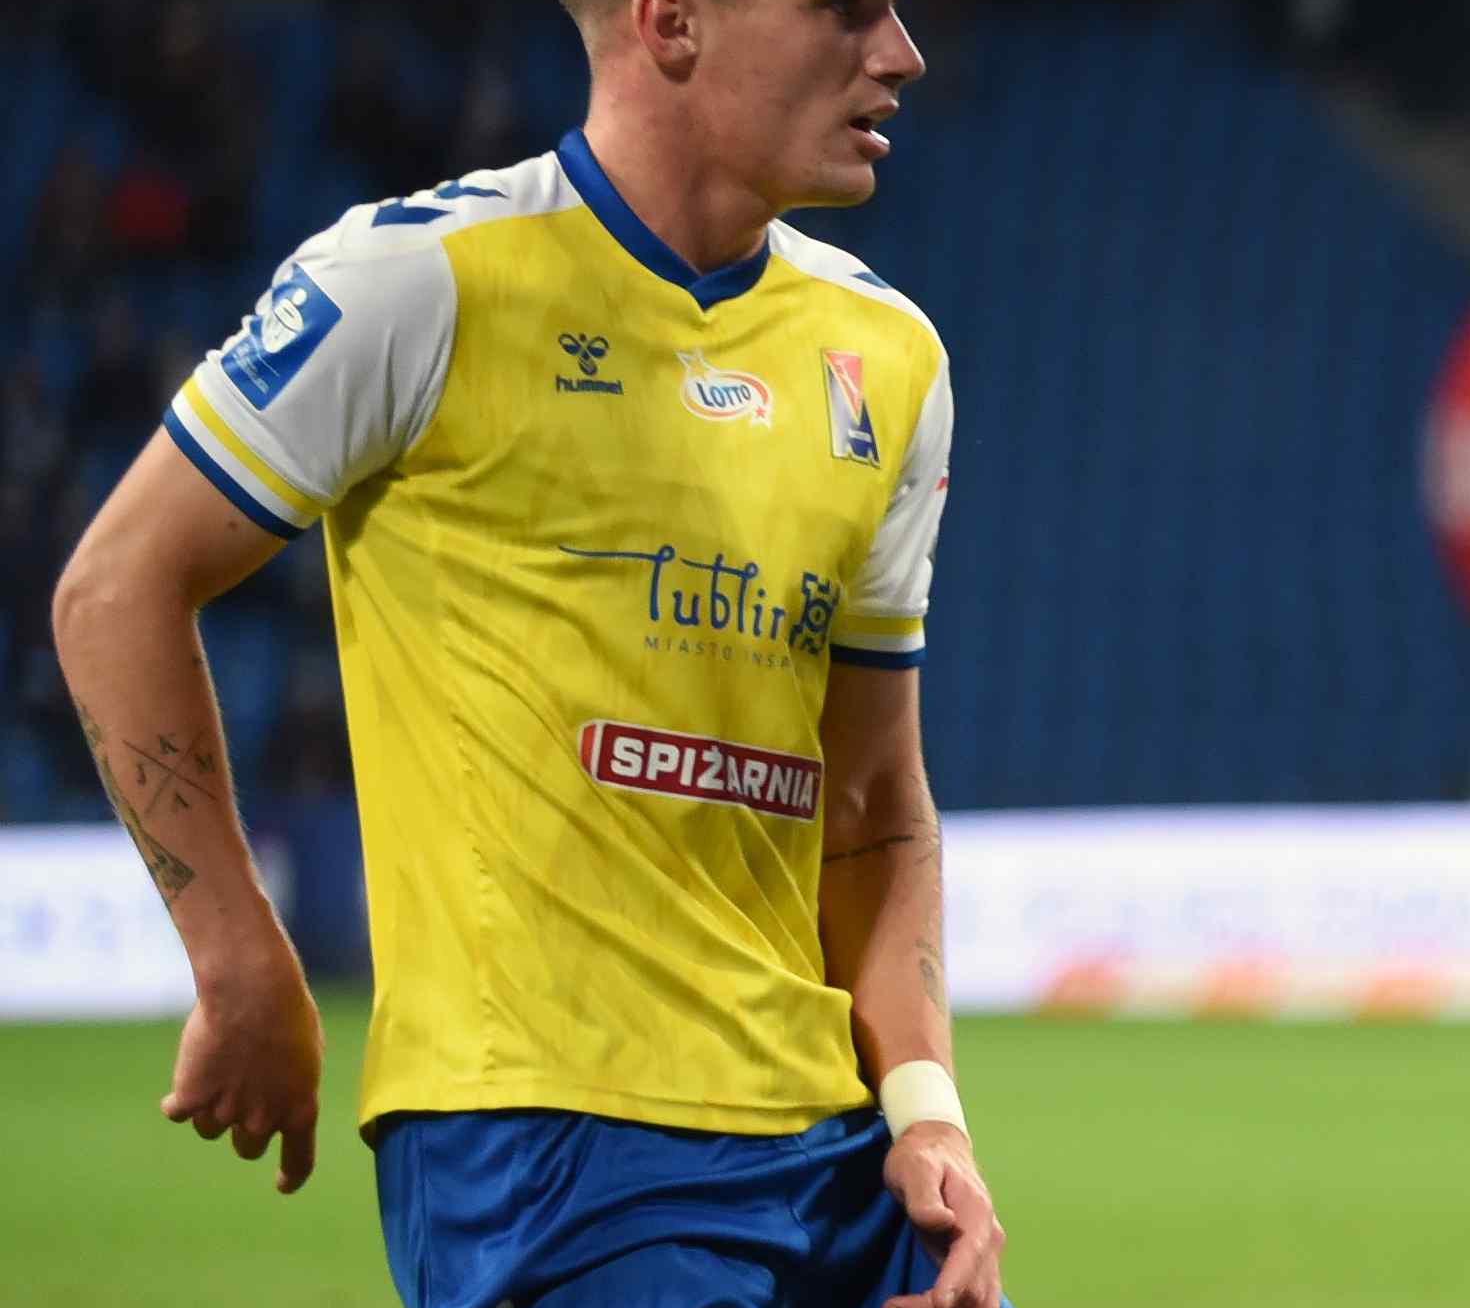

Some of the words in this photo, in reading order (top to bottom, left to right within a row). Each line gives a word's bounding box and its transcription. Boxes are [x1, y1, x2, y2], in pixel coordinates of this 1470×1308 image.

[555, 375, 624, 396] hummel
[697, 382, 752, 409] LOTTO
[610, 736, 814, 810] SPIŻARNIA
